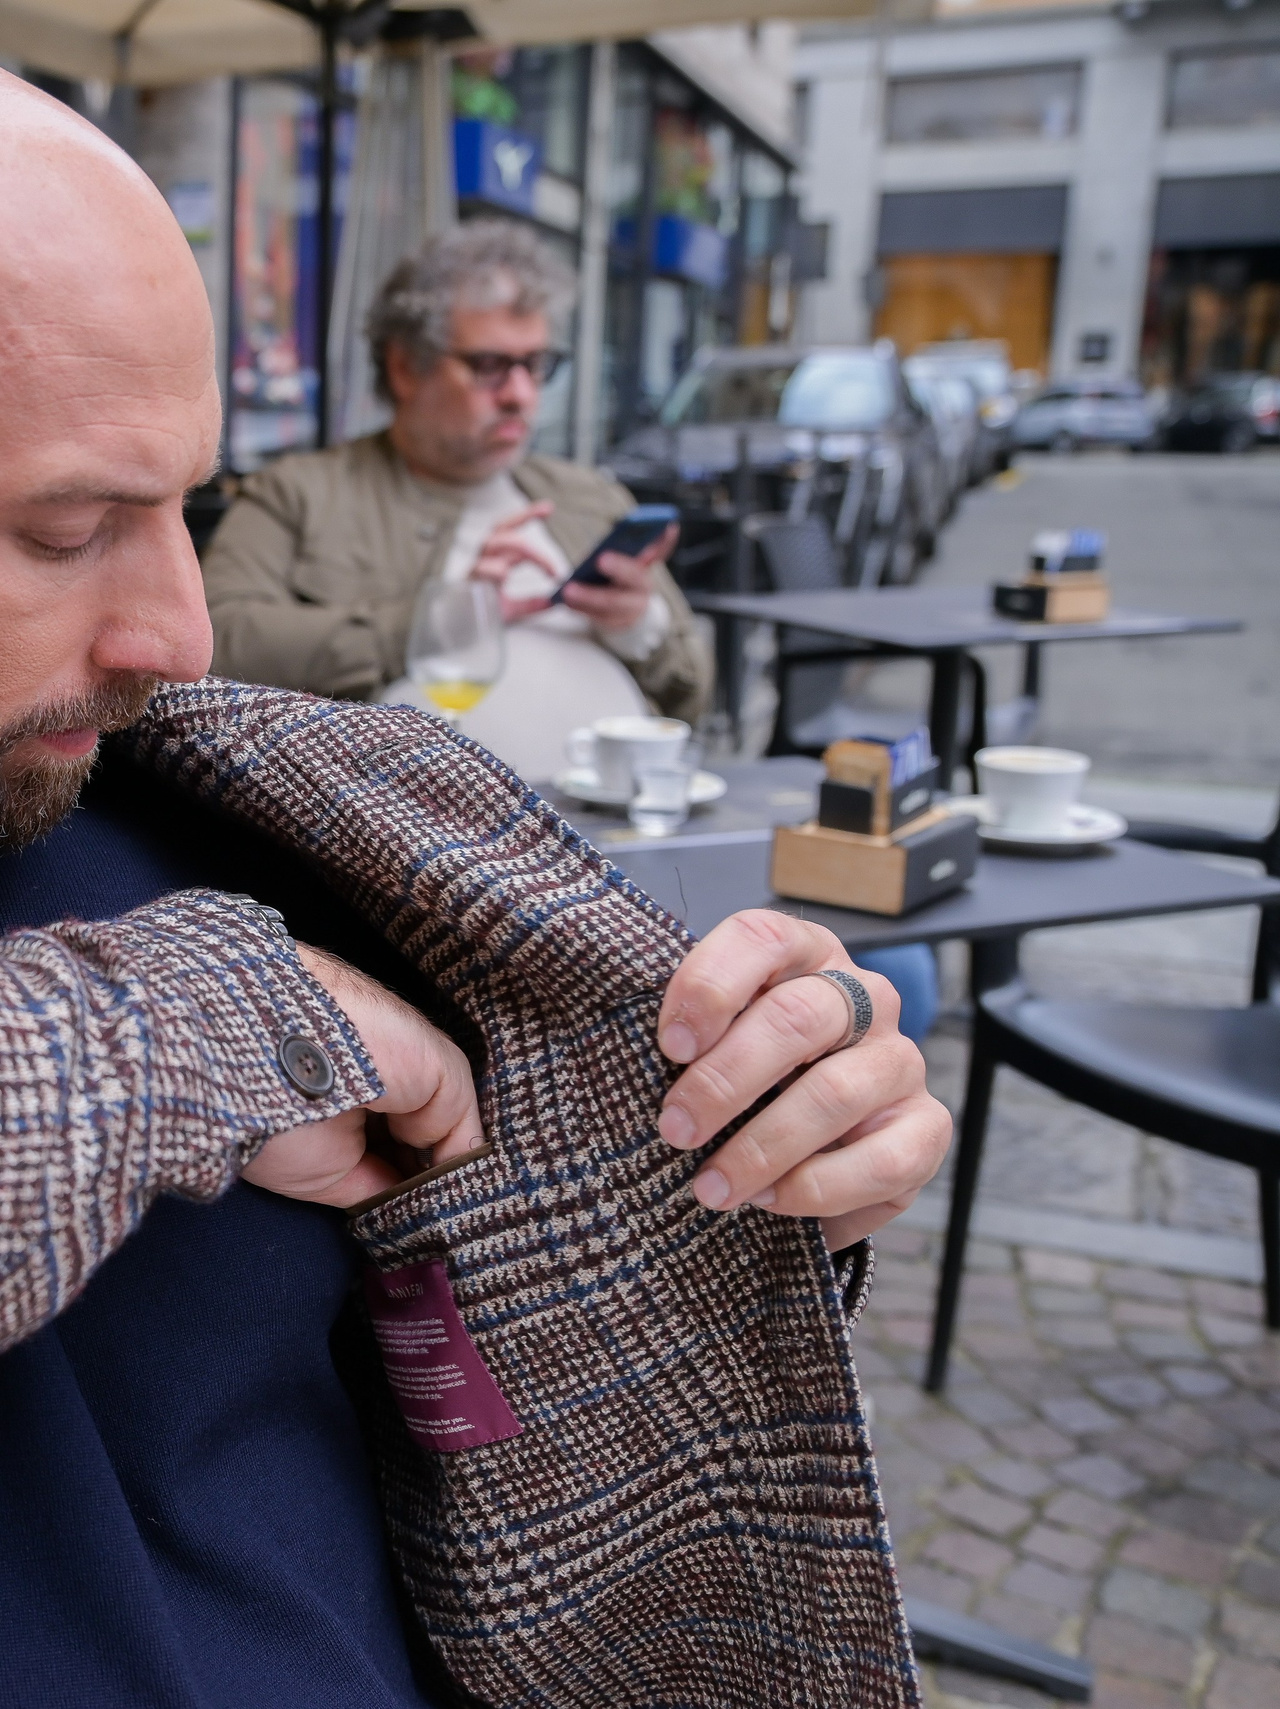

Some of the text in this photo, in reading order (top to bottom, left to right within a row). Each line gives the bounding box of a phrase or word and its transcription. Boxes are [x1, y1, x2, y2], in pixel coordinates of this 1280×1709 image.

[438, 1371, 465, 1381] dialogue
[436, 1379, 467, 1390] showcase
[440, 1418, 450, 1426] for
[451, 1417, 466, 1425] you.
[447, 1423, 475, 1433] lifetime.
